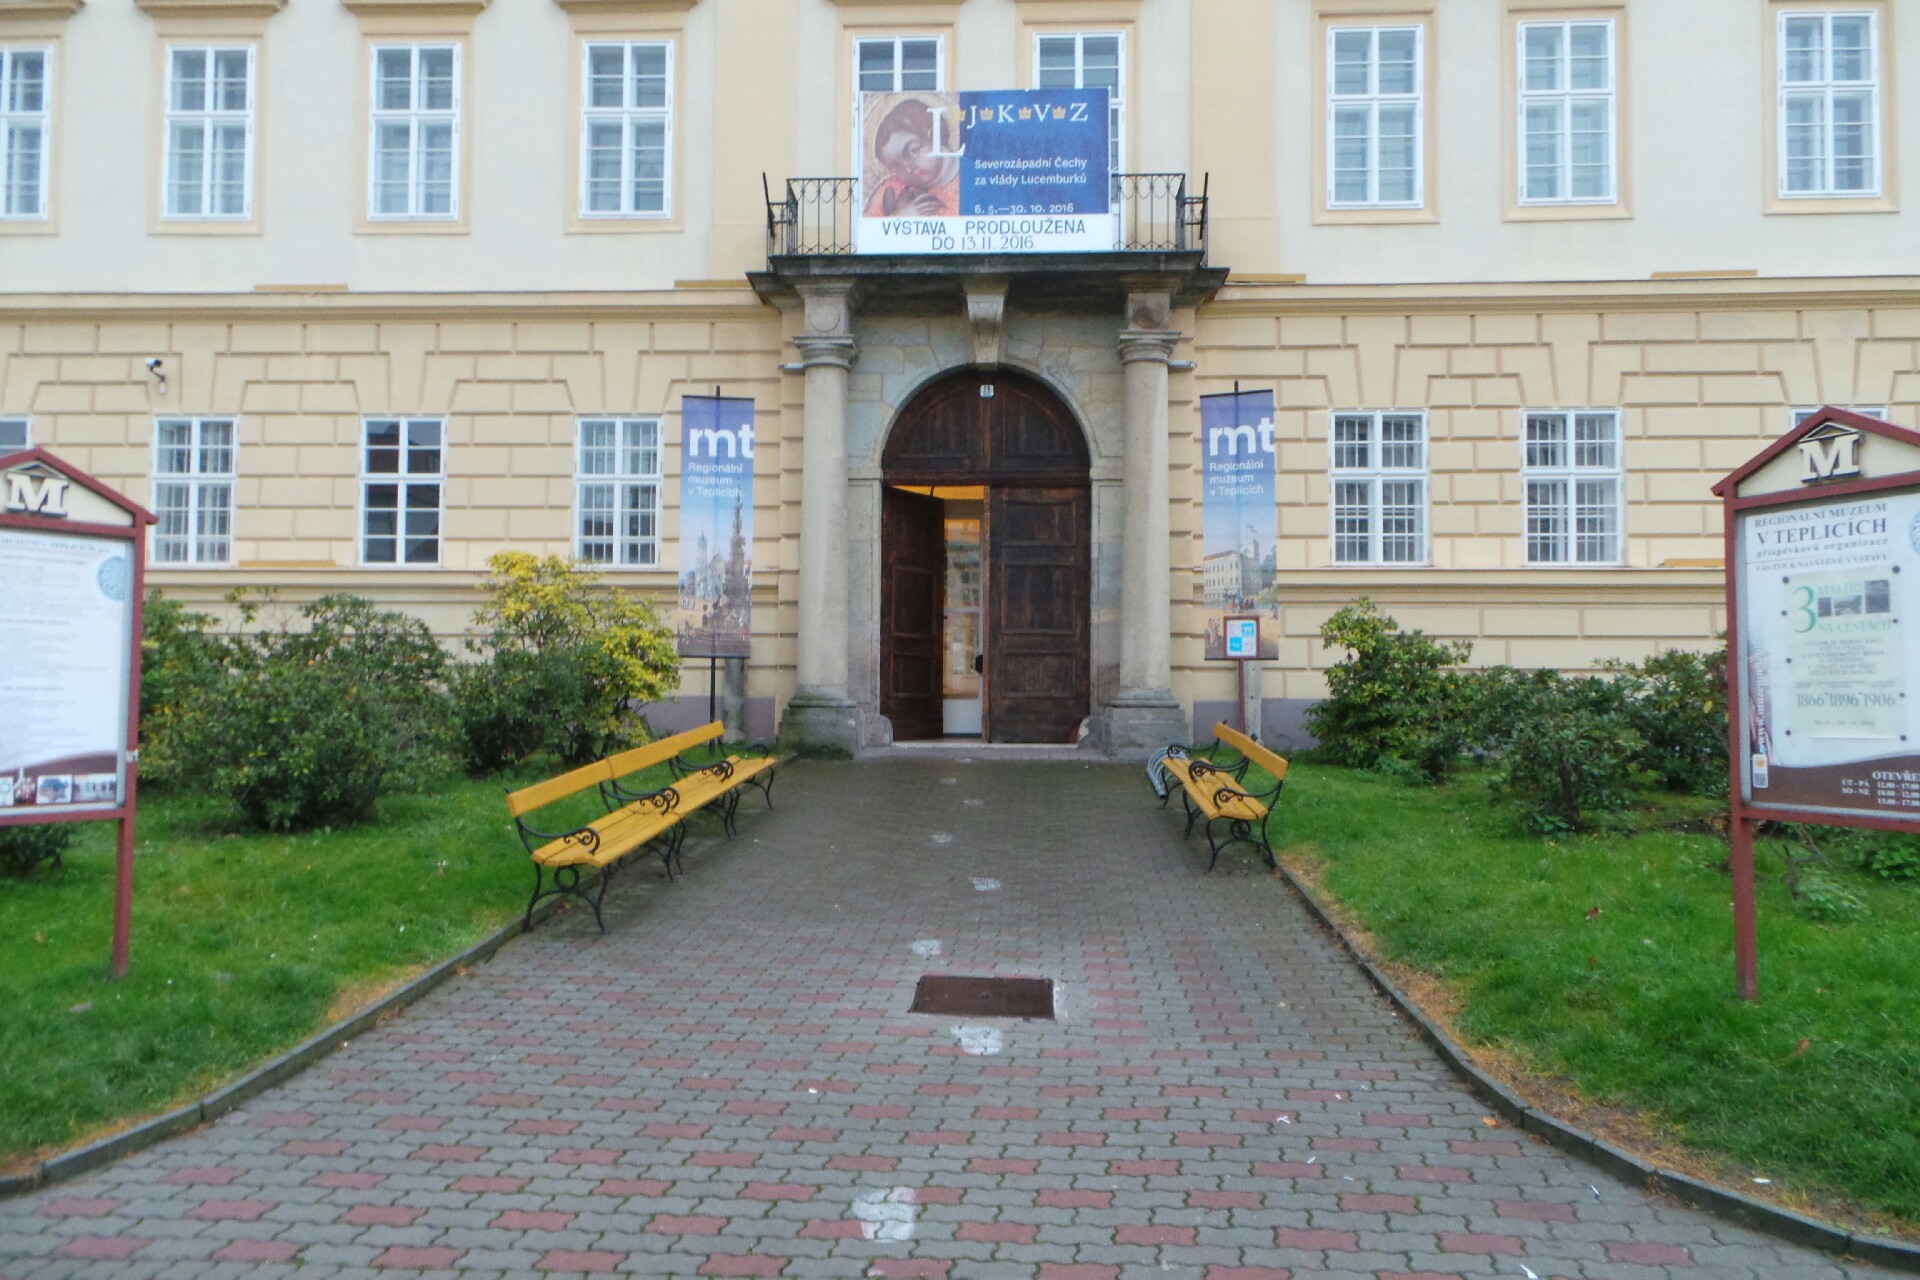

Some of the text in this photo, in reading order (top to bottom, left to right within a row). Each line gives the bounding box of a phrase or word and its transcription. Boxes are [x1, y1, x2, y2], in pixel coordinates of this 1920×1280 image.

[927, 102, 1089, 157] L J K V Z
[974, 156, 1087, 170] Severozápadní Čechy
[974, 173, 1087, 187] za vlády Lucemburků
[974, 204, 985, 214] 6.
[1030, 204, 1046, 213] 10.
[1049, 203, 1074, 213] 2016
[882, 217, 1086, 236] VÝSTAVA PRODLOUŽENA
[931, 237, 955, 250] DO
[1000, 235, 1034, 250] 2016
[1799, 433, 1862, 483] M
[688, 462, 743, 474] Regionální
[1209, 459, 1264, 473] Regionální
[688, 475, 732, 485] muzeum
[1209, 474, 1254, 485] muzeum
[6, 472, 69, 518] M
[687, 486, 742, 498] v Teplicích
[1219, 484, 1264, 497] Teplicích
[1754, 503, 1886, 528] REGIONÁLNÍ MUZEUM
[1757, 517, 1887, 545] V TEPLICÍCH
[1756, 537, 1888, 560] příspěvková organizace
[1793, 585, 1817, 634] 3
[1797, 691, 1896, 708] 1866 1896 1906
